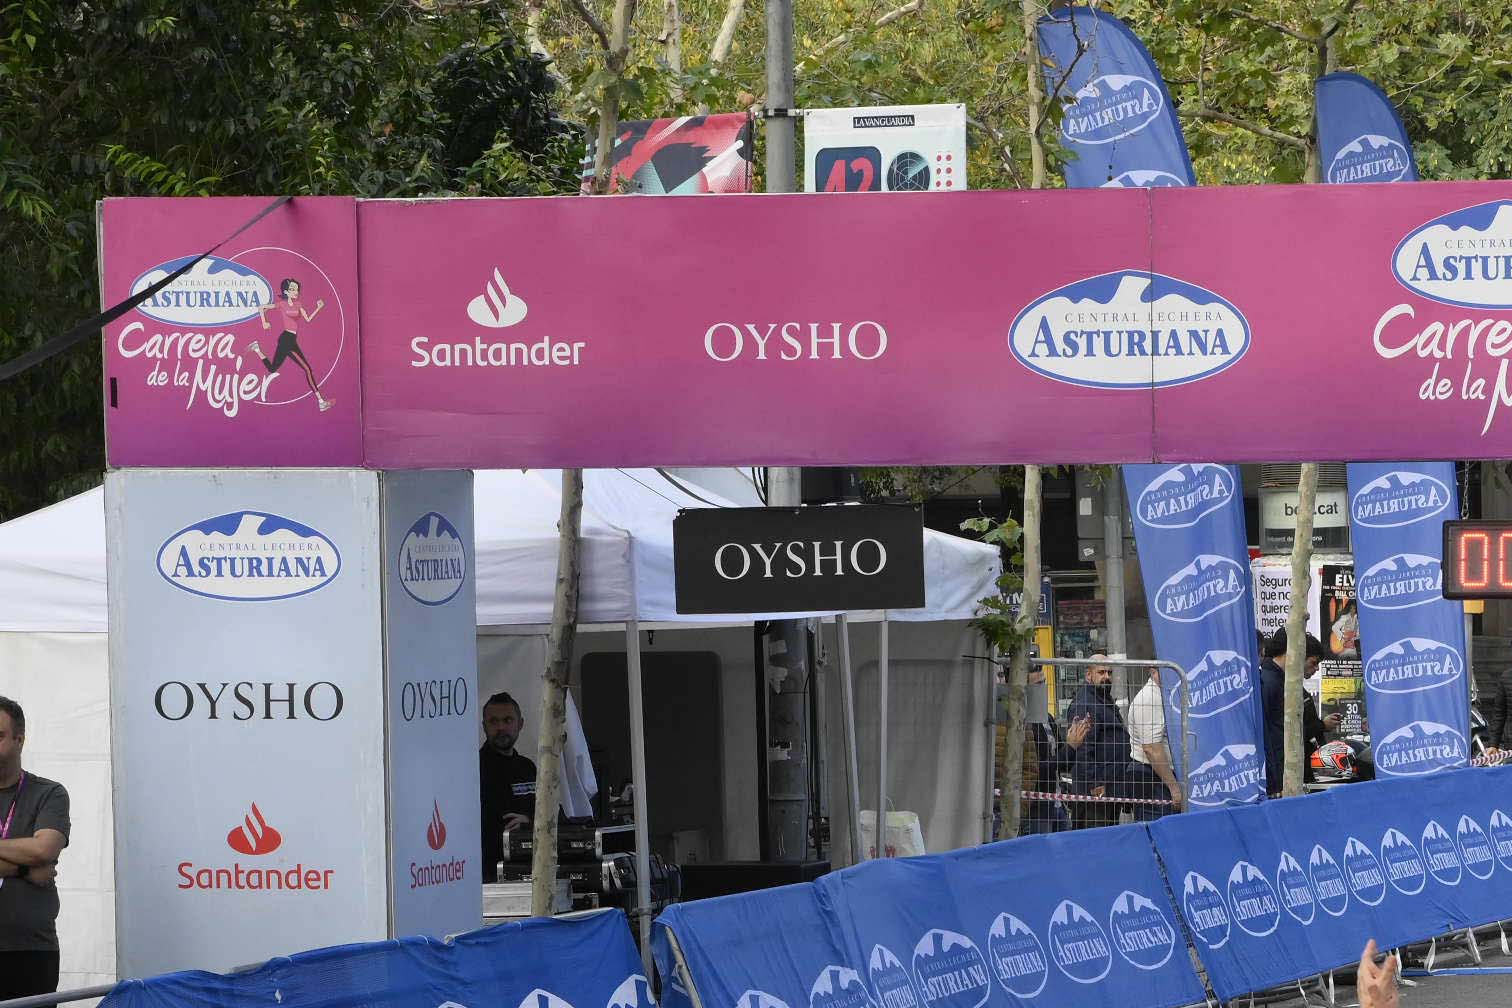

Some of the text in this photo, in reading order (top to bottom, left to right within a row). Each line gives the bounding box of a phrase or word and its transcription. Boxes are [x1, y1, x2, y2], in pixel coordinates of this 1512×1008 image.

[166, 279, 257, 287] ENTRAL LECHERA
[1064, 311, 1223, 323] CENTRAL LECHERA
[118, 322, 236, 359] Carrera
[410, 335, 585, 368] Santander
[704, 321, 888, 361] OYSHO
[1030, 316, 1231, 359] ASTURIANA
[147, 356, 280, 418] de la Mujer
[1419, 363, 1454, 401] de
[1461, 362, 1487, 401] la
[171, 544, 328, 579] ASTURIANA
[199, 543, 321, 552] CENTRAL LECHERA
[403, 545, 462, 583] ASTURIANA
[714, 538, 887, 580] OYSHO
[1260, 592, 1277, 602] que
[1335, 574, 1355, 587] ELV
[1261, 604, 1292, 614] quiere
[154, 680, 344, 721] OYSHO
[402, 677, 468, 722] OYSHO
[1346, 704, 1358, 714] 30
[177, 862, 334, 890] Santander
[410, 857, 466, 890] Santander
